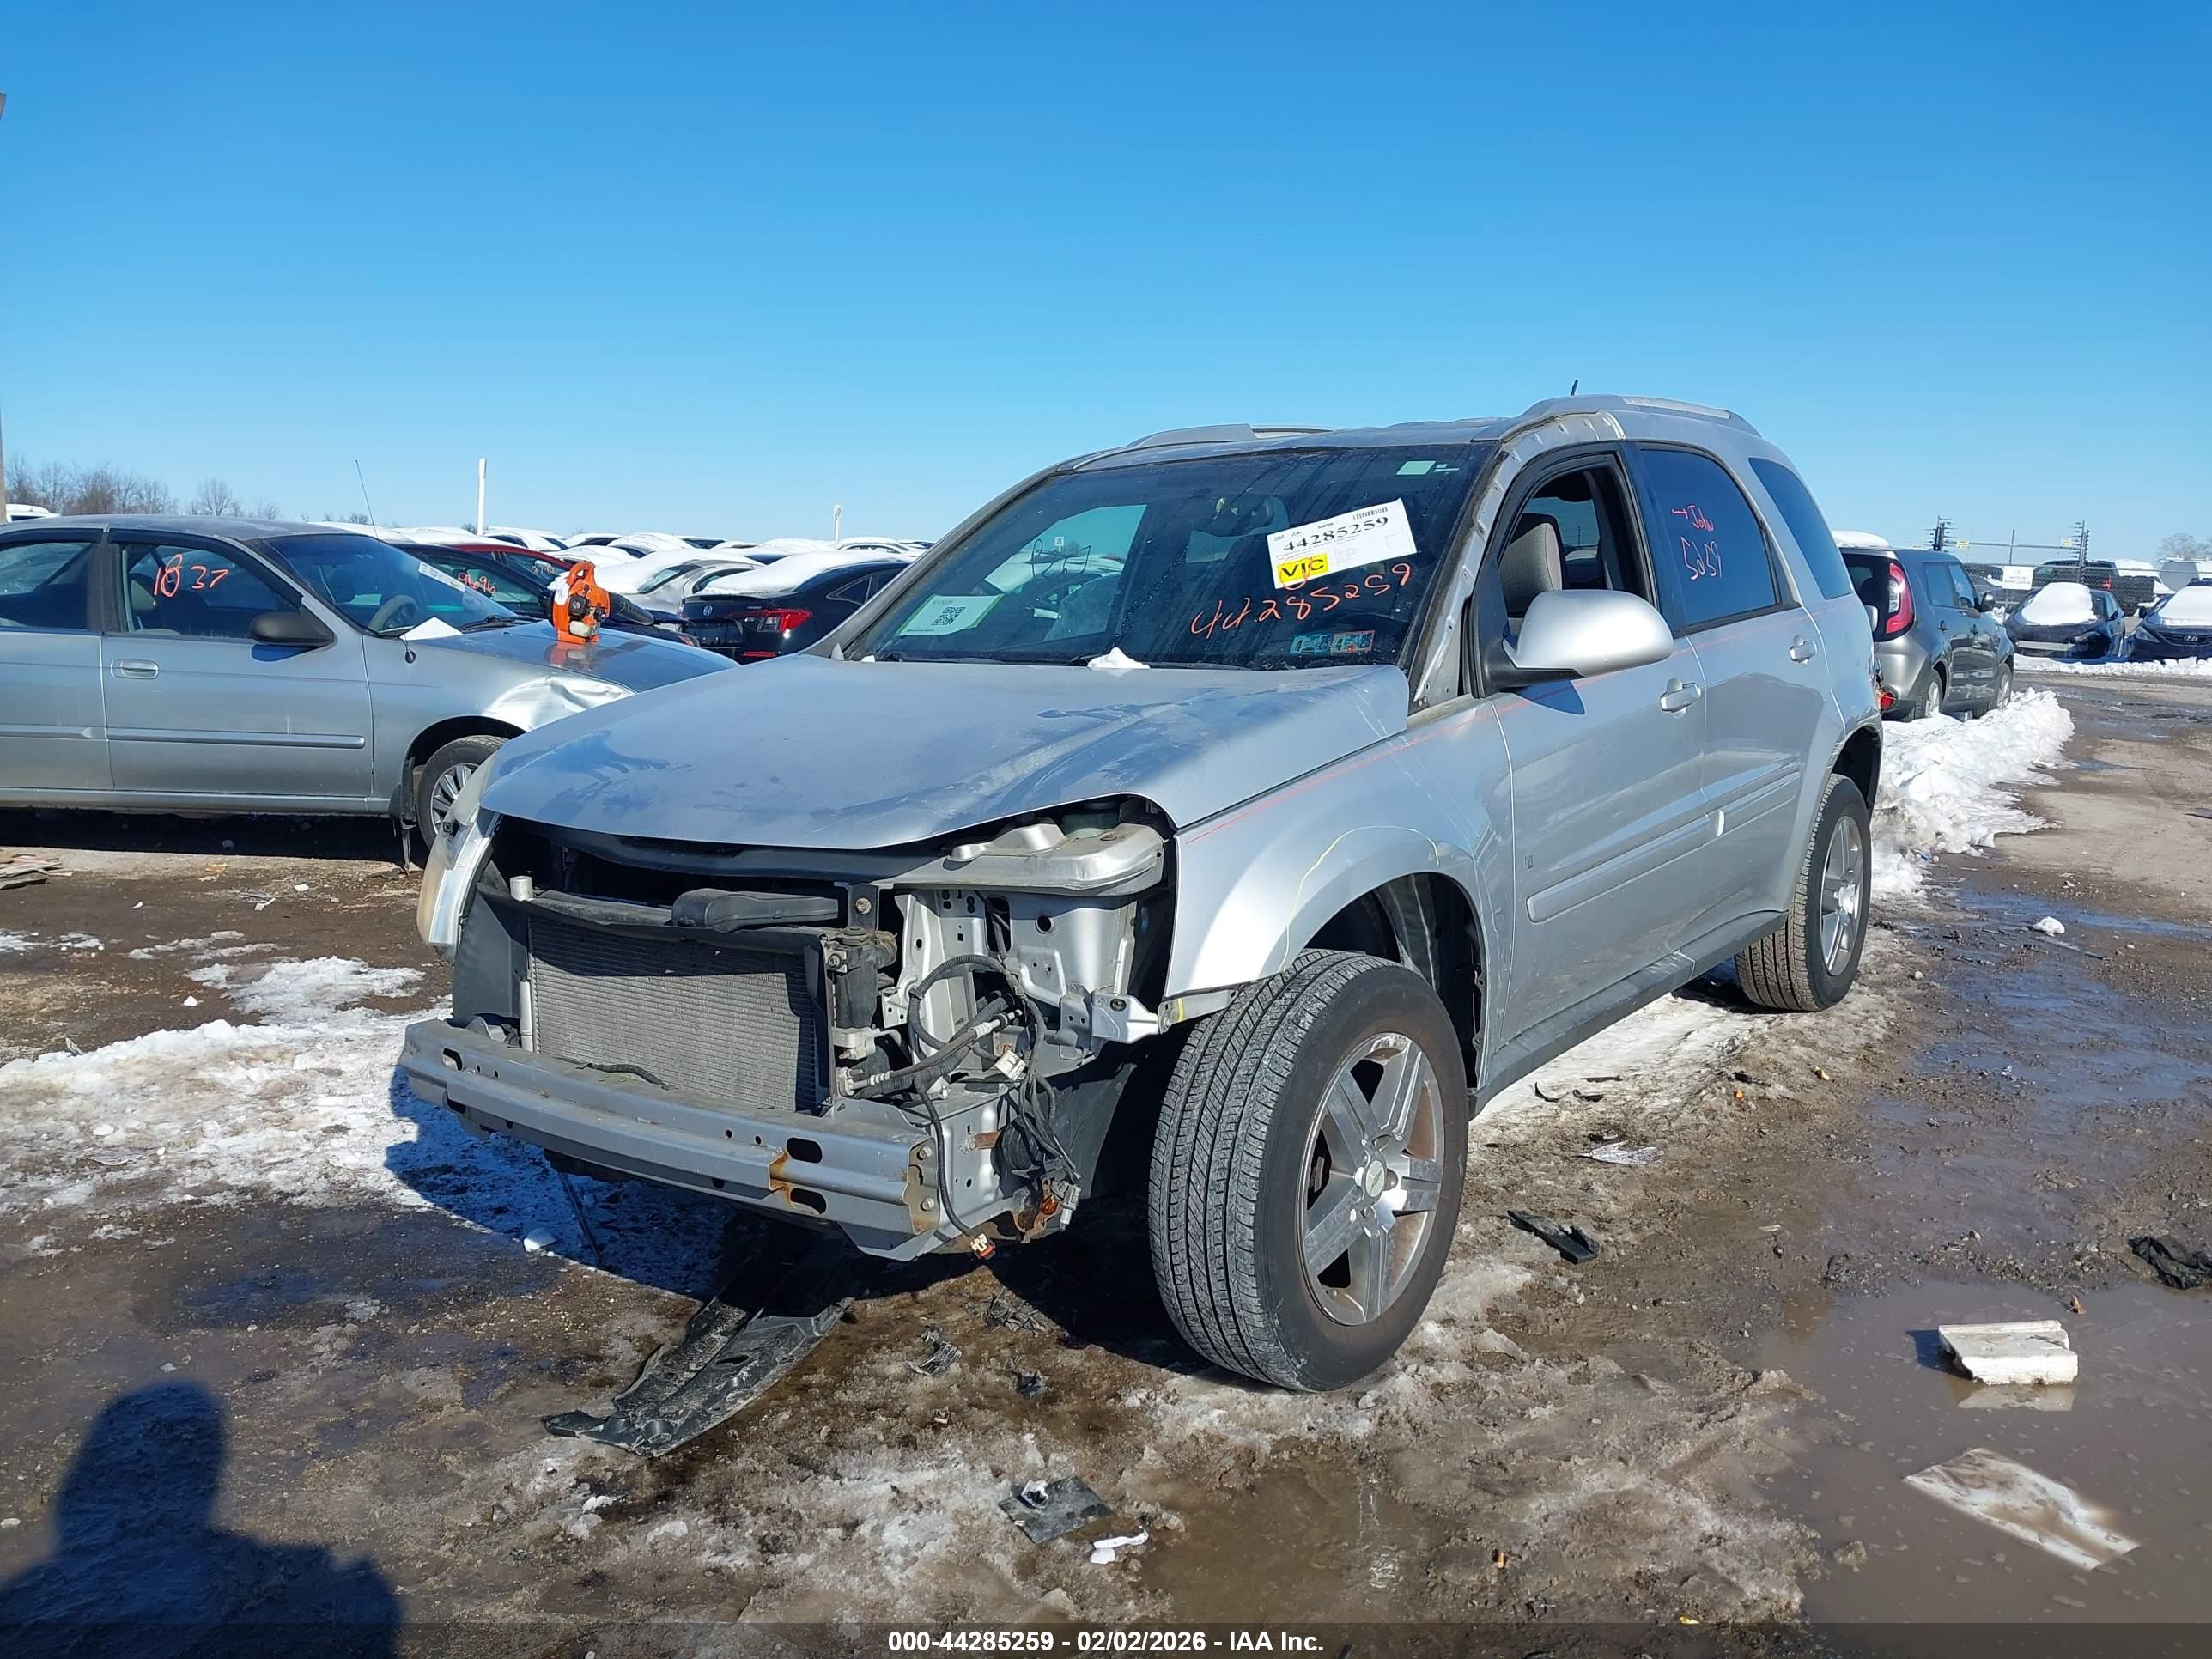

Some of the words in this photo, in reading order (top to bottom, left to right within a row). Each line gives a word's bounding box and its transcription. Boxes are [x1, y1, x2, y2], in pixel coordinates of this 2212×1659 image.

[1283, 516, 1389, 551] 44285259
[1281, 558, 1325, 577] VIC
[1190, 562, 1412, 639] 44285259
